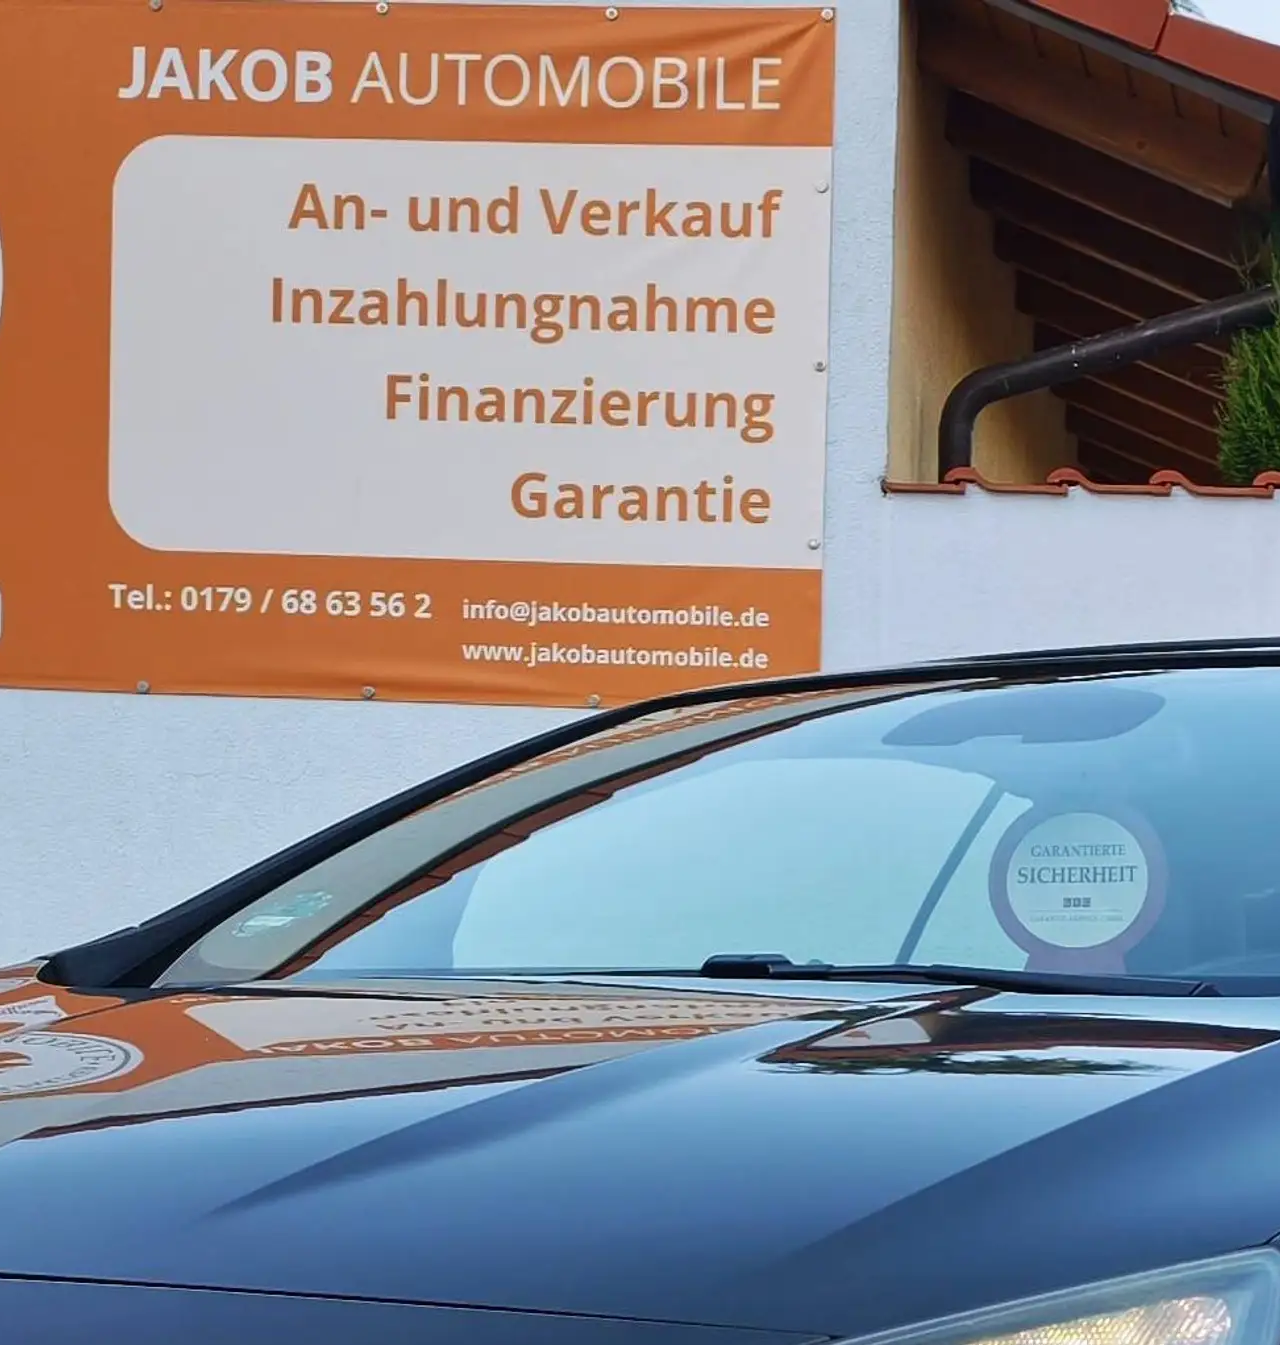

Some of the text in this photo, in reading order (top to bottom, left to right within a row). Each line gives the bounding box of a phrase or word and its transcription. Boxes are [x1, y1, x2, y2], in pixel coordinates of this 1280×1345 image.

[119, 46, 782, 110] JAKOB AUTOMOBILE
[288, 183, 782, 238] An- und Verkauf
[272, 278, 776, 344] Inzahlungnahme
[386, 373, 775, 443] Finanzierung
[511, 473, 771, 524] Garantie
[109, 584, 432, 619] Tel.: 0179 / 68 63 56 2
[462, 599, 769, 628] info@jakobautomobile.de
[462, 641, 768, 669] www.jakobautomobile.de
[1031, 844, 1126, 857] GARANTIERTE
[1017, 865, 1138, 884] SICHERHEIT
